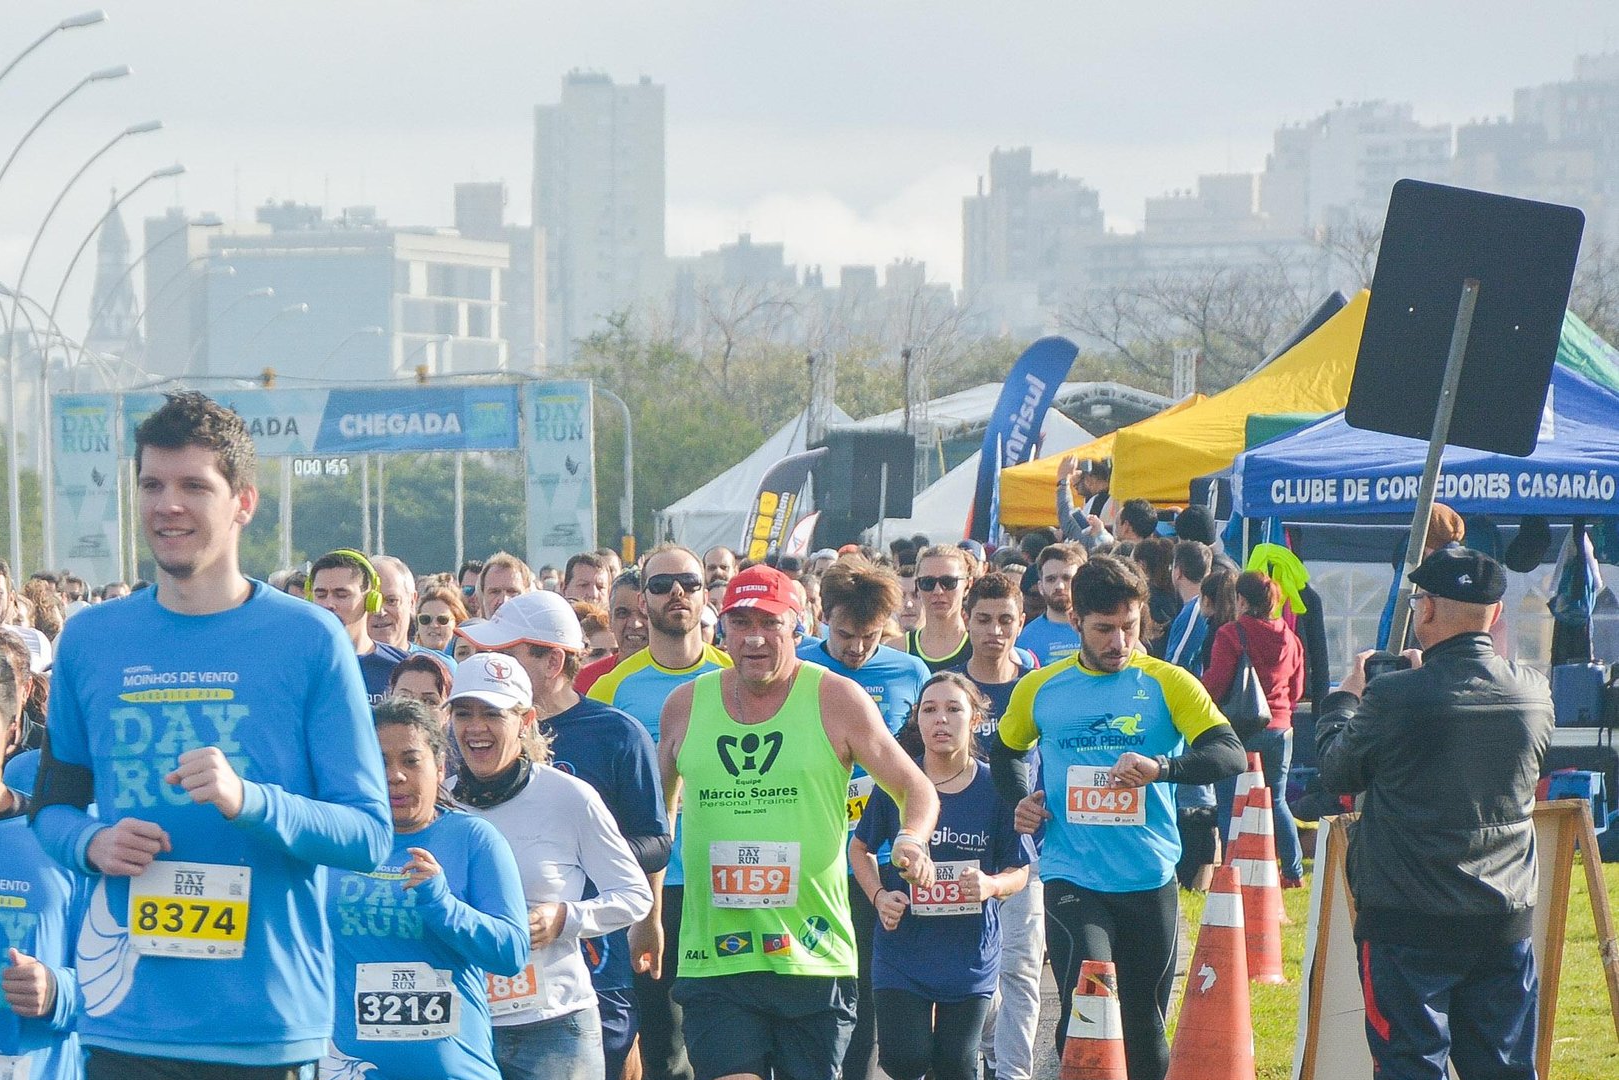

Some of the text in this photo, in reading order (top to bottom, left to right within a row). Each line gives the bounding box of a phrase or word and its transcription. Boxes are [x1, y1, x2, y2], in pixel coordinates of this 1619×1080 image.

[535, 403, 581, 423] DAY
[1006, 373, 1046, 466] nrisul
[61, 415, 107, 433] DAY
[339, 412, 462, 438] CHEGADA
[536, 423, 583, 442] RUN
[62, 434, 110, 452] RUN
[1271, 469, 1615, 503] CLUBE DE COREDORES CASARÃO
[123, 671, 239, 687] MOINHOS DE VENTO
[110, 704, 250, 756] DAY
[1058, 735, 1146, 750] VICTOR PERKOV
[111, 756, 249, 809] RU
[699, 786, 798, 801] Márcio Soares
[699, 797, 798, 808] Personal Trainer
[1073, 790, 1133, 811] 1049
[931, 826, 990, 846] gibank
[738, 849, 759, 857] DAY
[738, 856, 759, 865] RUN
[175, 873, 206, 885] DAY
[715, 869, 783, 892] 1159
[936, 873, 954, 881] RUN
[174, 884, 205, 896] RUN
[916, 883, 960, 902] 503
[138, 900, 236, 935] 8374
[337, 905, 423, 940] RUN
[392, 973, 416, 982] DAY
[392, 981, 416, 990] RUN
[486, 971, 530, 998] 88
[362, 996, 445, 1022] 3216
